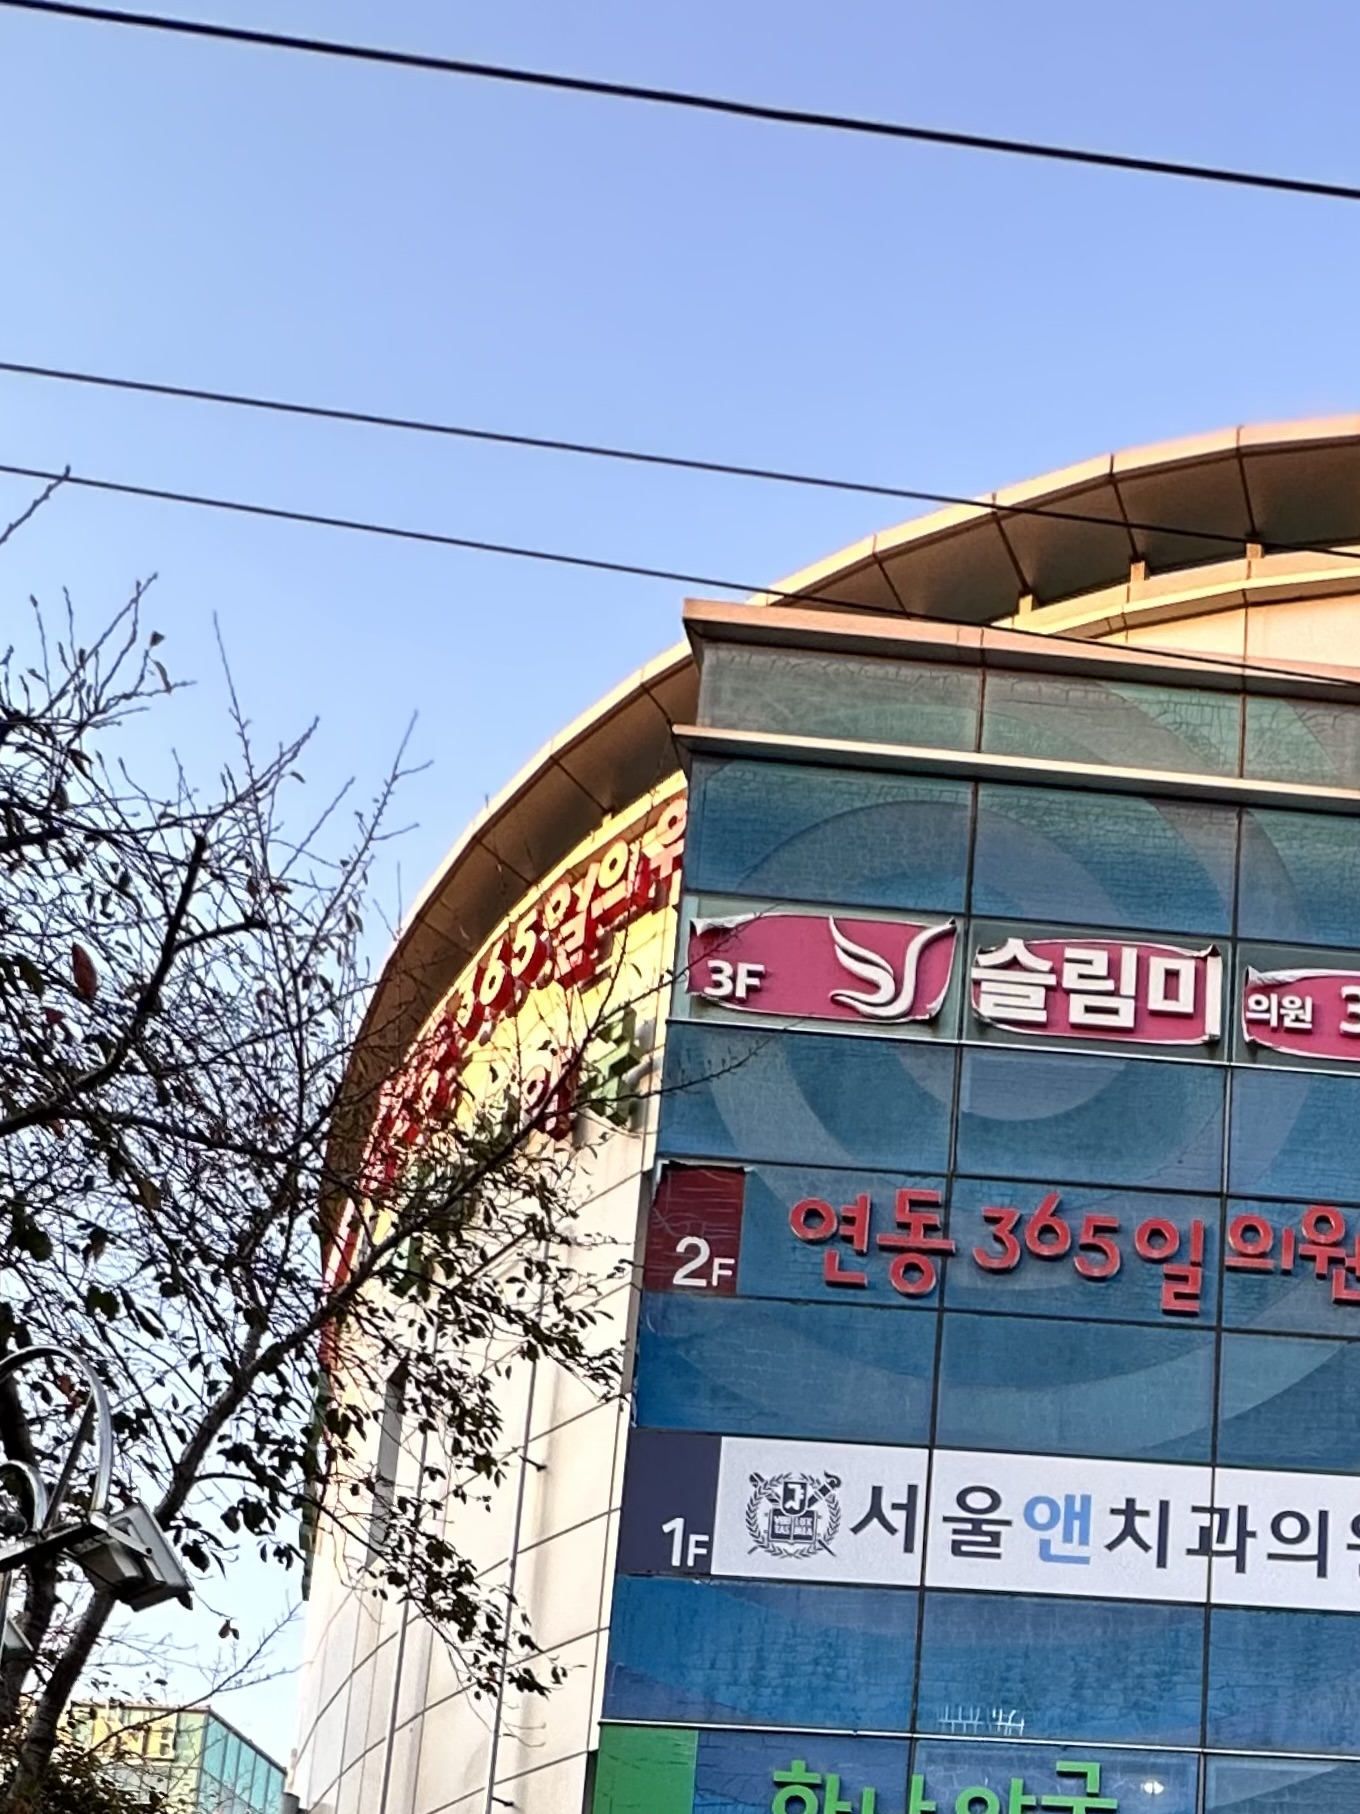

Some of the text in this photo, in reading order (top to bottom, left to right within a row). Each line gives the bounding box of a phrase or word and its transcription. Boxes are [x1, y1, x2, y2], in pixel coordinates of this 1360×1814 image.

[704, 959, 765, 998] 3F
[972, 937, 1222, 1043] 슬림미
[1245, 993, 1314, 1031] 의원
[673, 1236, 735, 1288] 2F
[661, 1516, 709, 1568] 1F
